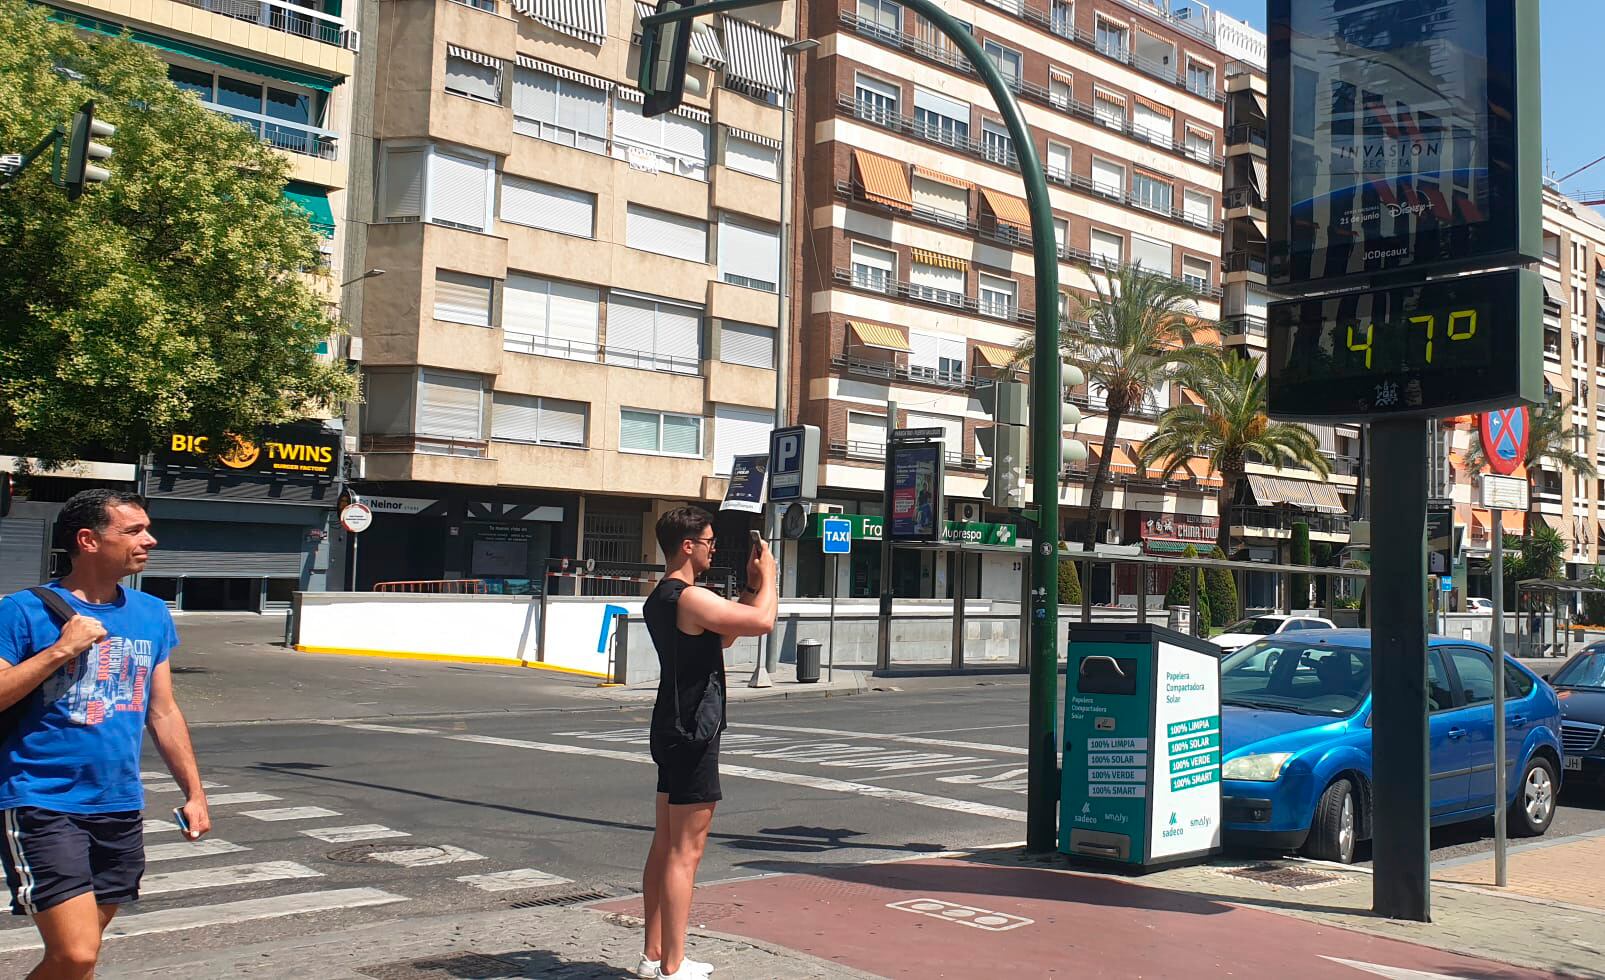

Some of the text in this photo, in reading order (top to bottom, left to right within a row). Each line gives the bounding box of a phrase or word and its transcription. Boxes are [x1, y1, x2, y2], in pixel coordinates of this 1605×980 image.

[1340, 217, 1349, 225] 21
[1350, 214, 1360, 223] de
[1363, 247, 1408, 260] JCDecaux
[265, 442, 332, 463] TWINS
[778, 435, 798, 472] P
[370, 499, 403, 510] Neinor
[826, 531, 850, 541] TAXI
[1177, 525, 1201, 537] CHINA
[134, 639, 153, 655] CITY
[134, 655, 152, 667] YORK
[1166, 671, 1190, 681] Papelera
[1166, 683, 1205, 693] Compactadora
[1072, 697, 1094, 705] Papelera
[1166, 695, 1181, 704] Solar
[1071, 704, 1107, 713] Compactadora
[1071, 712, 1085, 720] Solar
[1170, 721, 1210, 736] 100% LIMPIA
[1091, 740, 1136, 749] 100% LIMPIA
[1171, 738, 1210, 753] 100% SOLAR
[1091, 756, 1134, 764] 100% SOLAR
[1172, 756, 1211, 771] 100% VERDE
[1091, 771, 1135, 779] 100% VERDE
[1173, 772, 1213, 789] 100% SMART
[1092, 787, 1136, 795] 100% SMART
[1074, 814, 1097, 824] sadeco
[1162, 828, 1184, 838] sadeco
